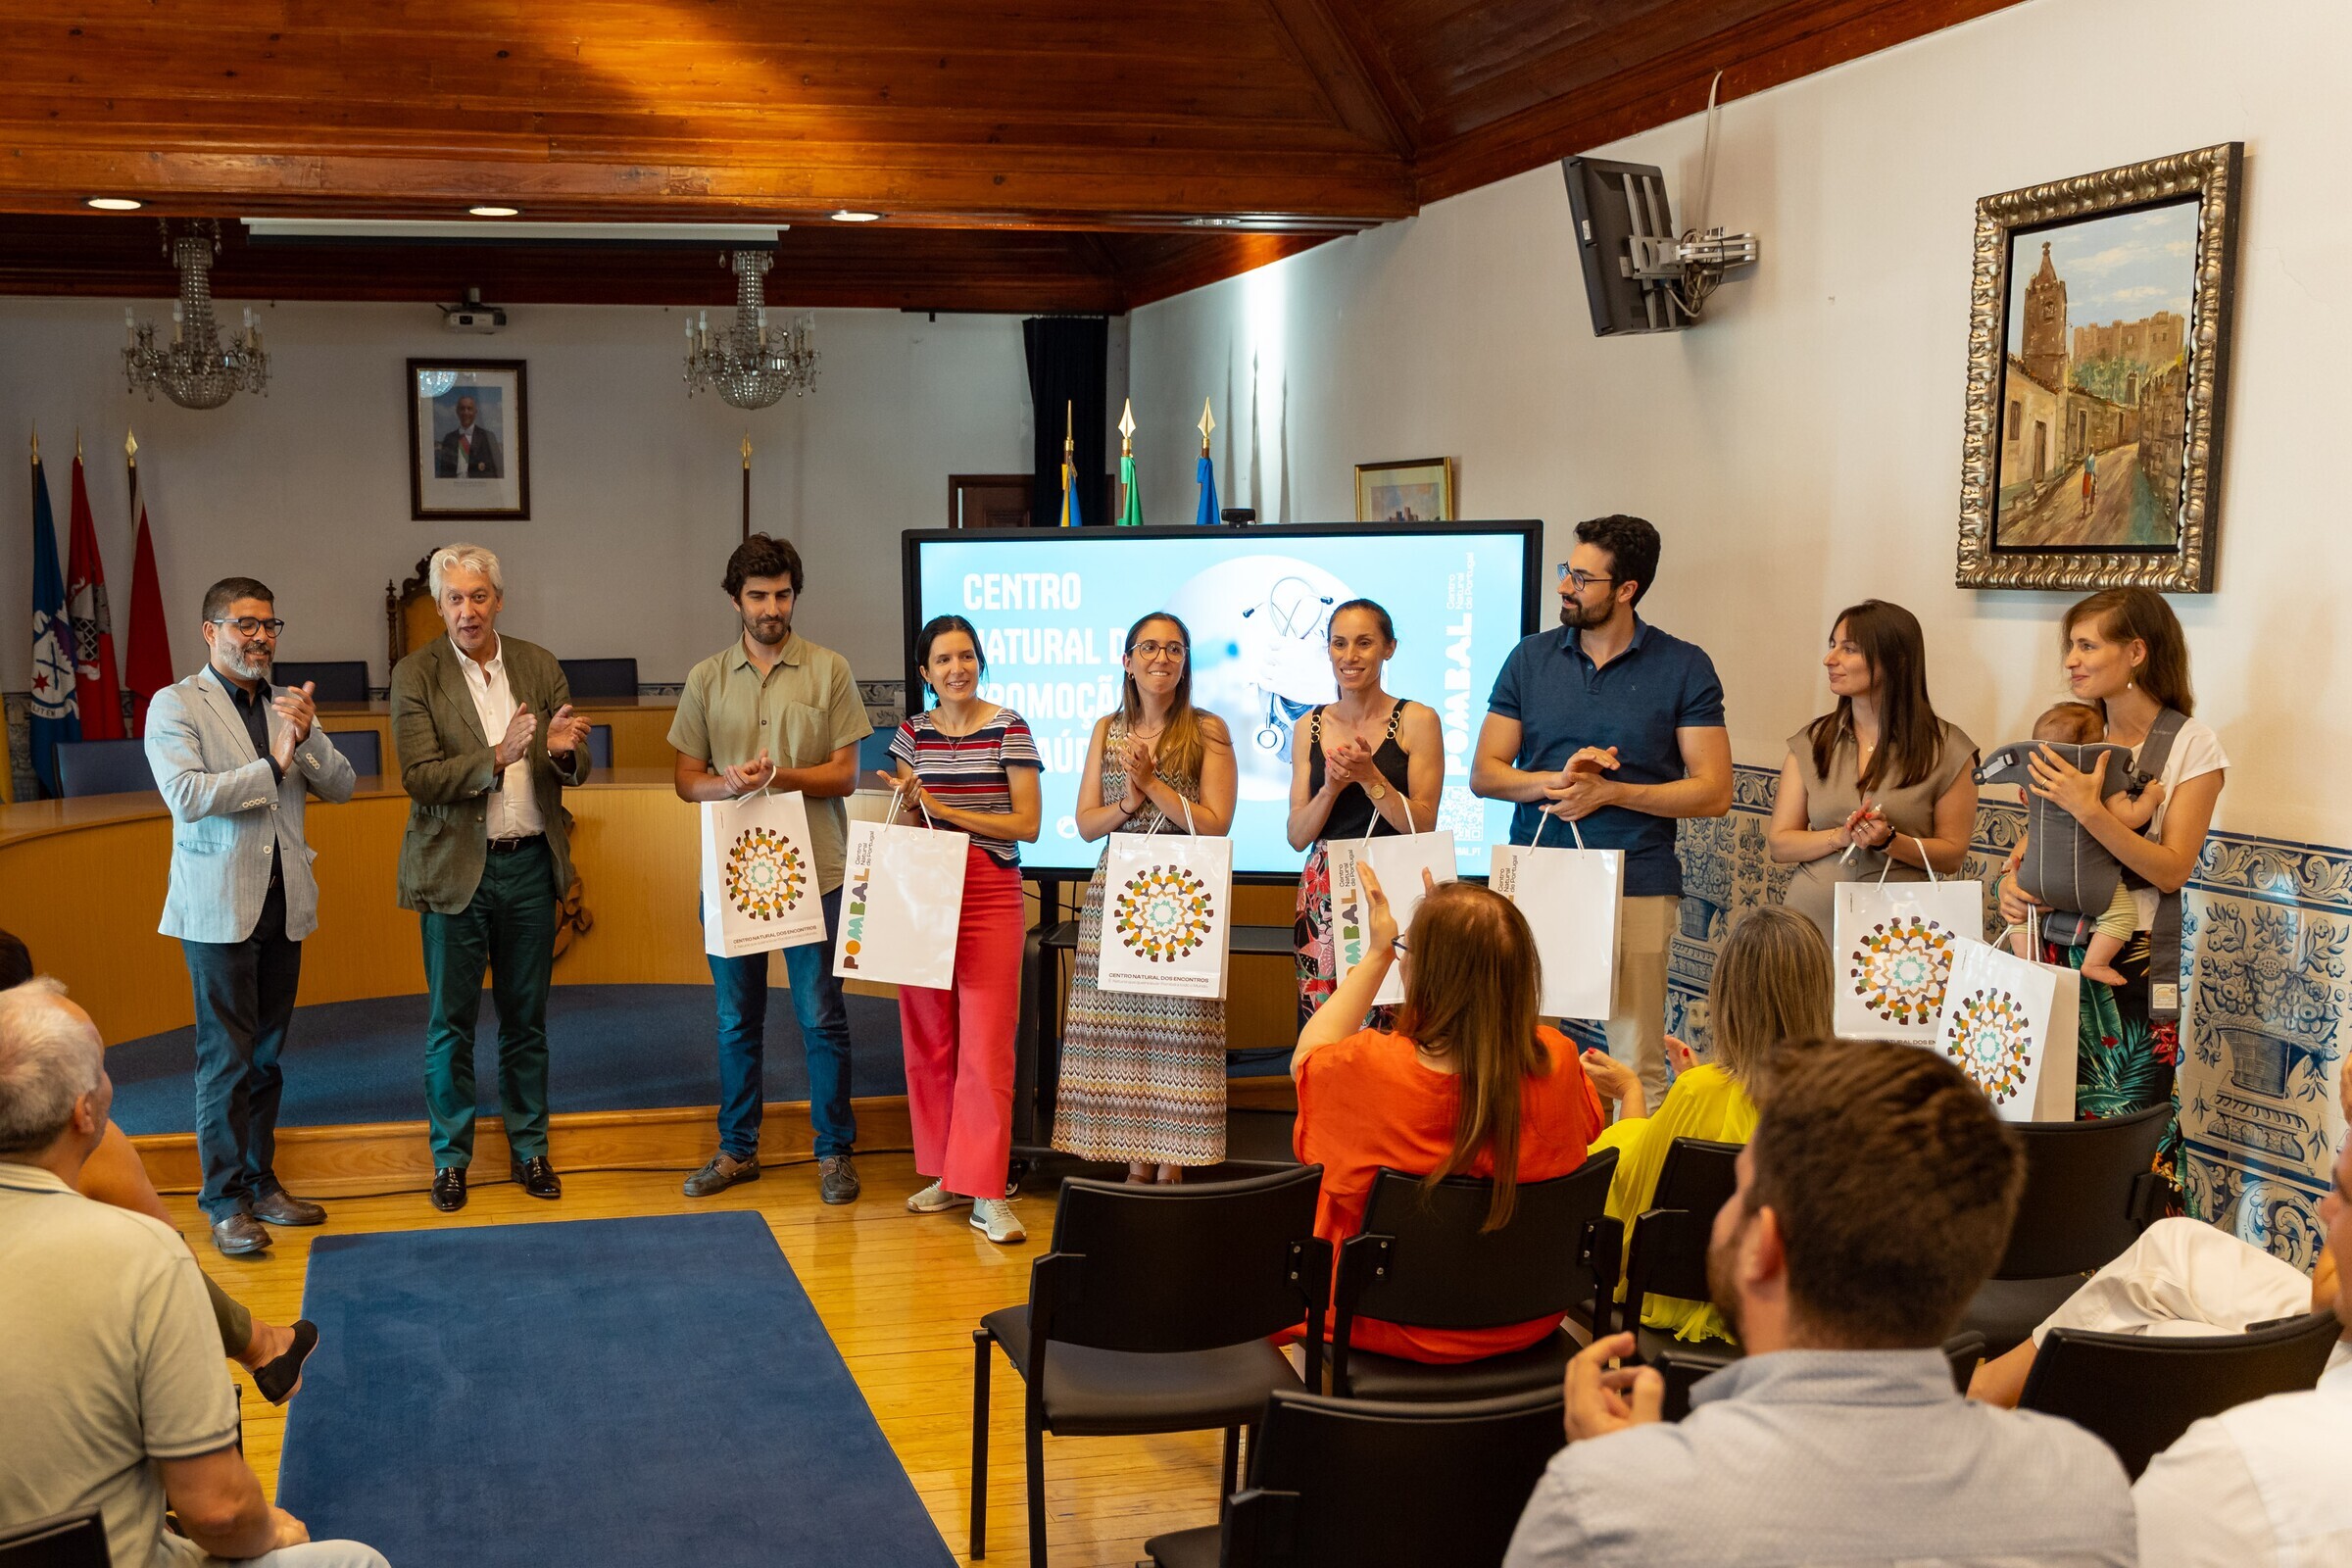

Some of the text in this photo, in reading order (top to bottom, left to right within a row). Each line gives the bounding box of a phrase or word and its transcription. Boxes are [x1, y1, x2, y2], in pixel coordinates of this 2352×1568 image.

[963, 572, 1082, 611] CENTRO
[1446, 574, 1455, 610] Centro
[1455, 572, 1464, 610] Natural
[1464, 552, 1476, 596] Portugal
[1109, 628, 1128, 665] D
[1444, 612, 1472, 776] POMBAL
[1348, 849, 1356, 878] Portugal
[1455, 847, 1481, 857] BAL.PT
[1509, 855, 1518, 884] Portugal
[753, 933, 776, 942] NATURAL
[787, 925, 817, 935] ENCONTROS
[843, 868, 870, 970] POMBAL
[1341, 889, 1361, 976] MBAL
